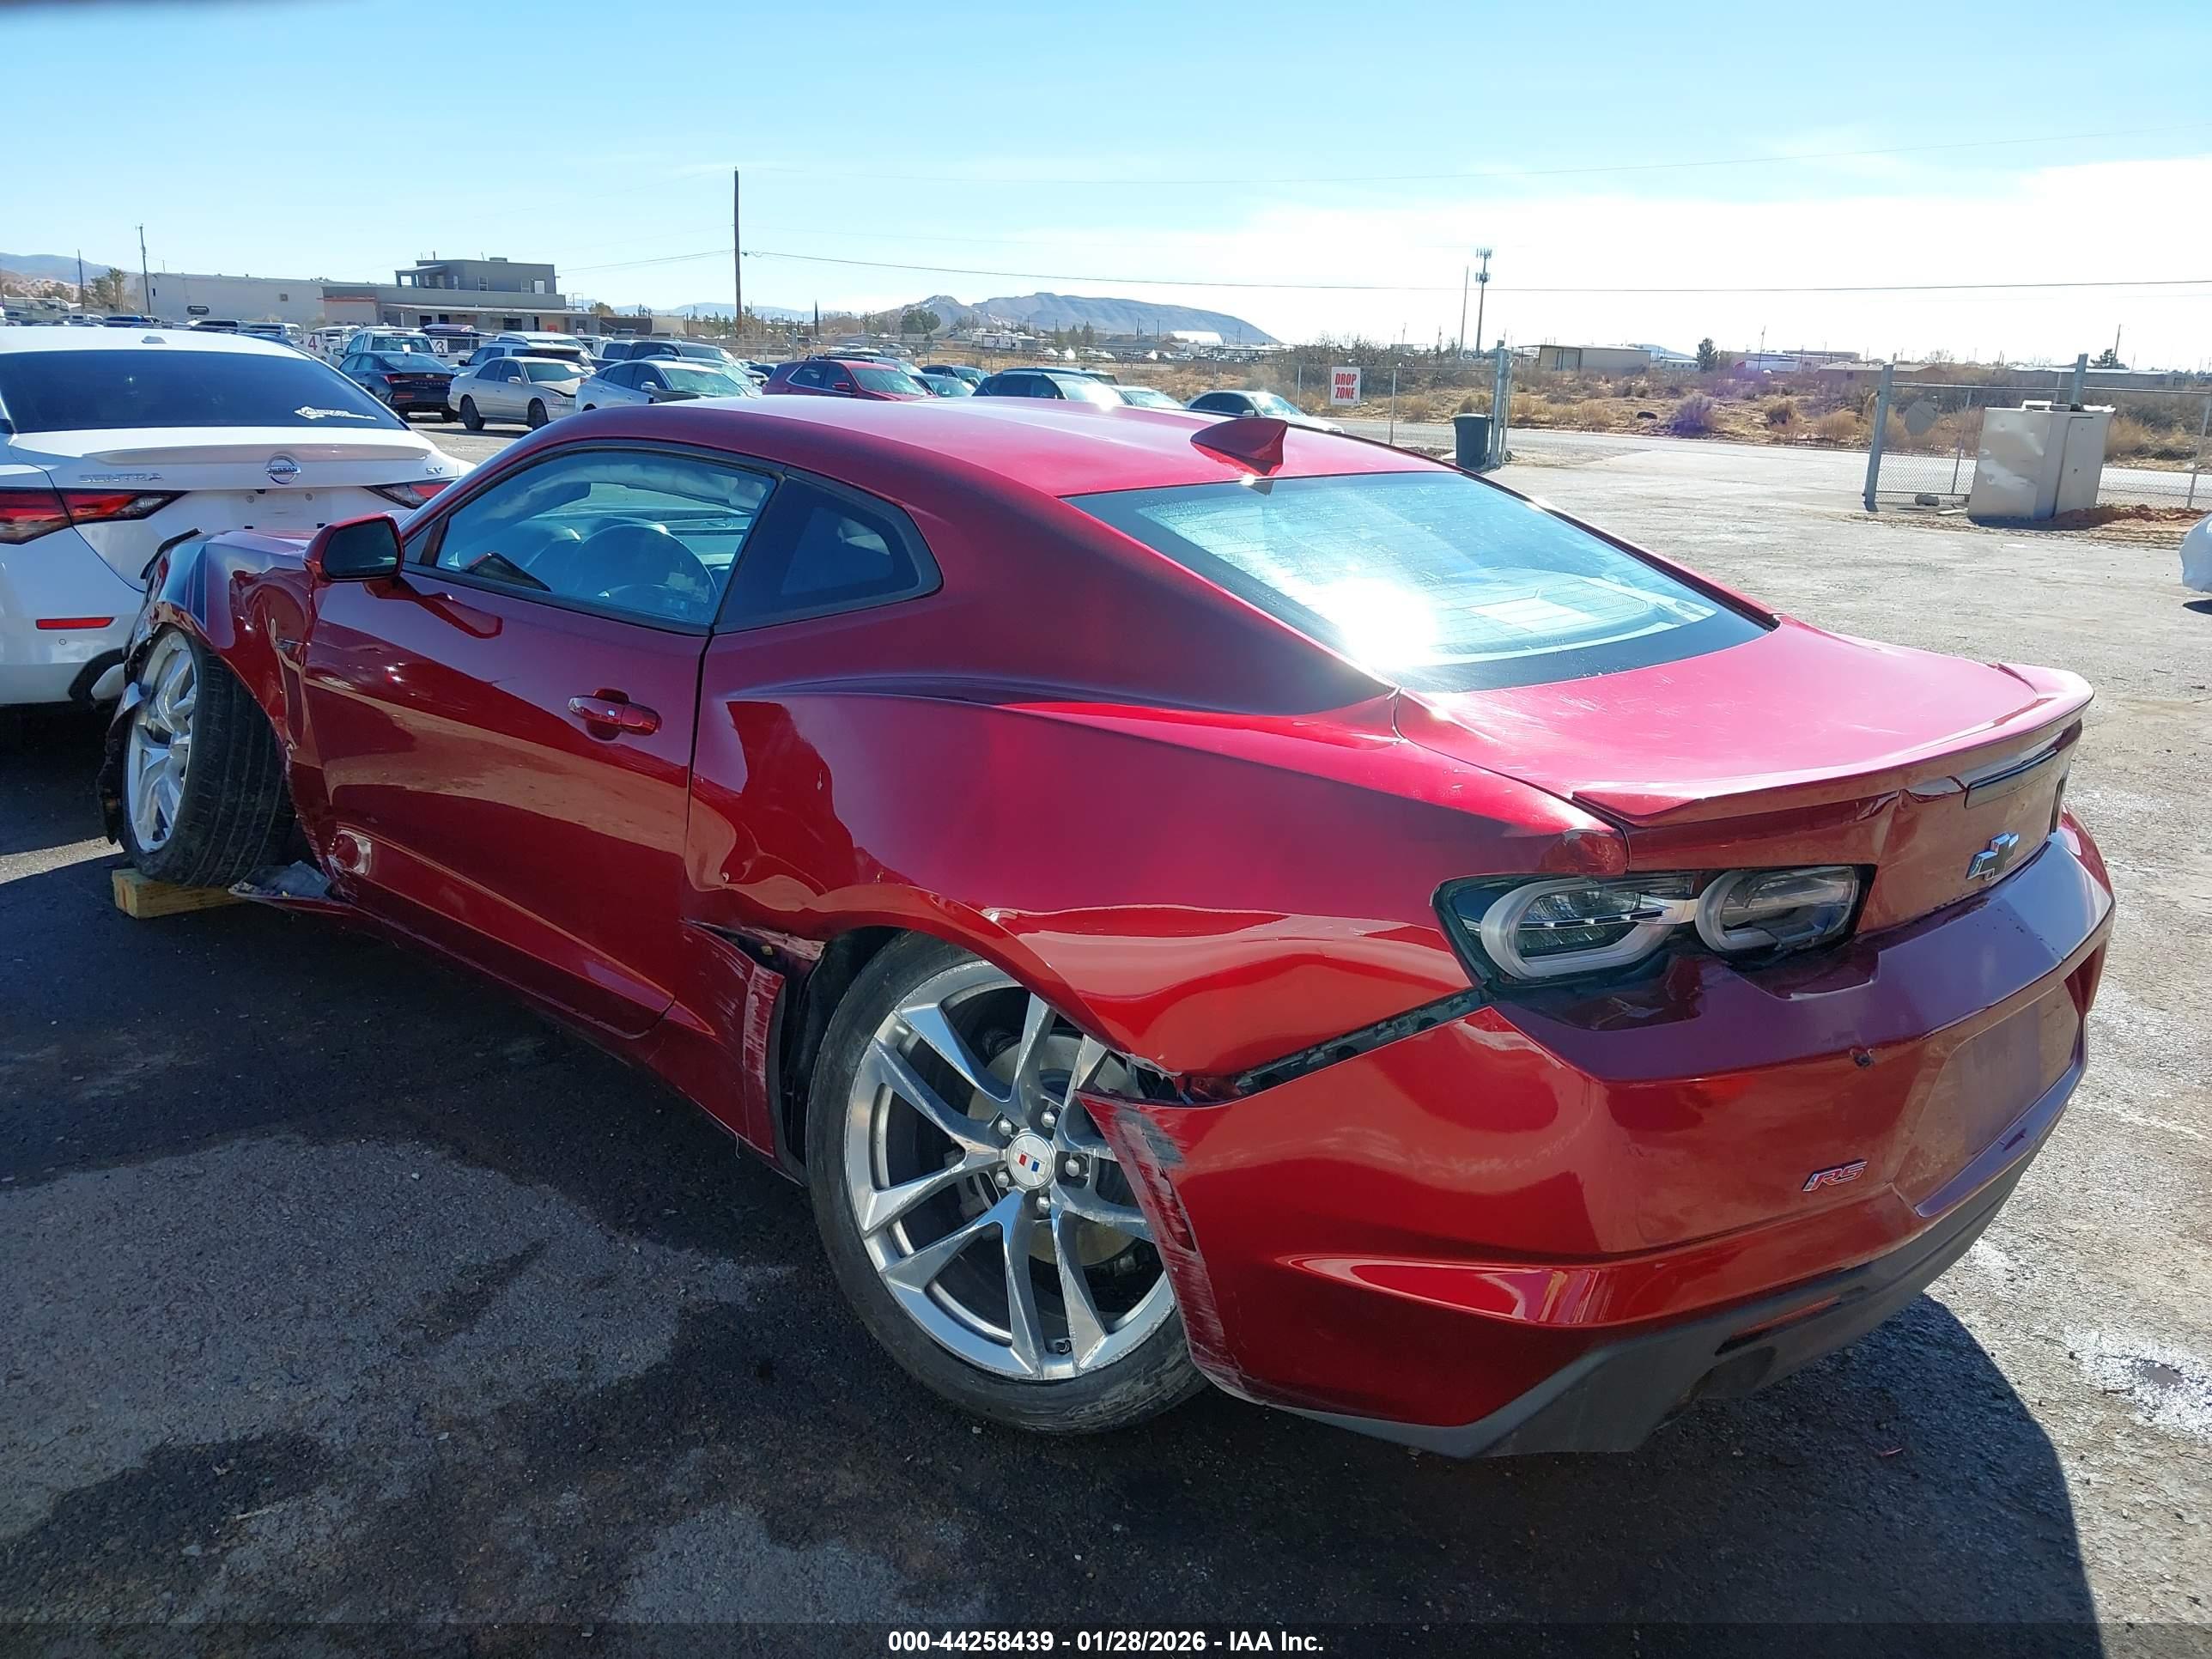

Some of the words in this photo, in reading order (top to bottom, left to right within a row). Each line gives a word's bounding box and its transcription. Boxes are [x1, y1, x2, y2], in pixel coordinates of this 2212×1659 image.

[307, 335, 318, 352] 4
[1334, 373, 1357, 386] DROP
[1334, 387, 1356, 399] ZONE
[425, 466, 444, 476] SV
[79, 473, 165, 483] SENTRA
[1802, 1159, 1869, 1192] RS
